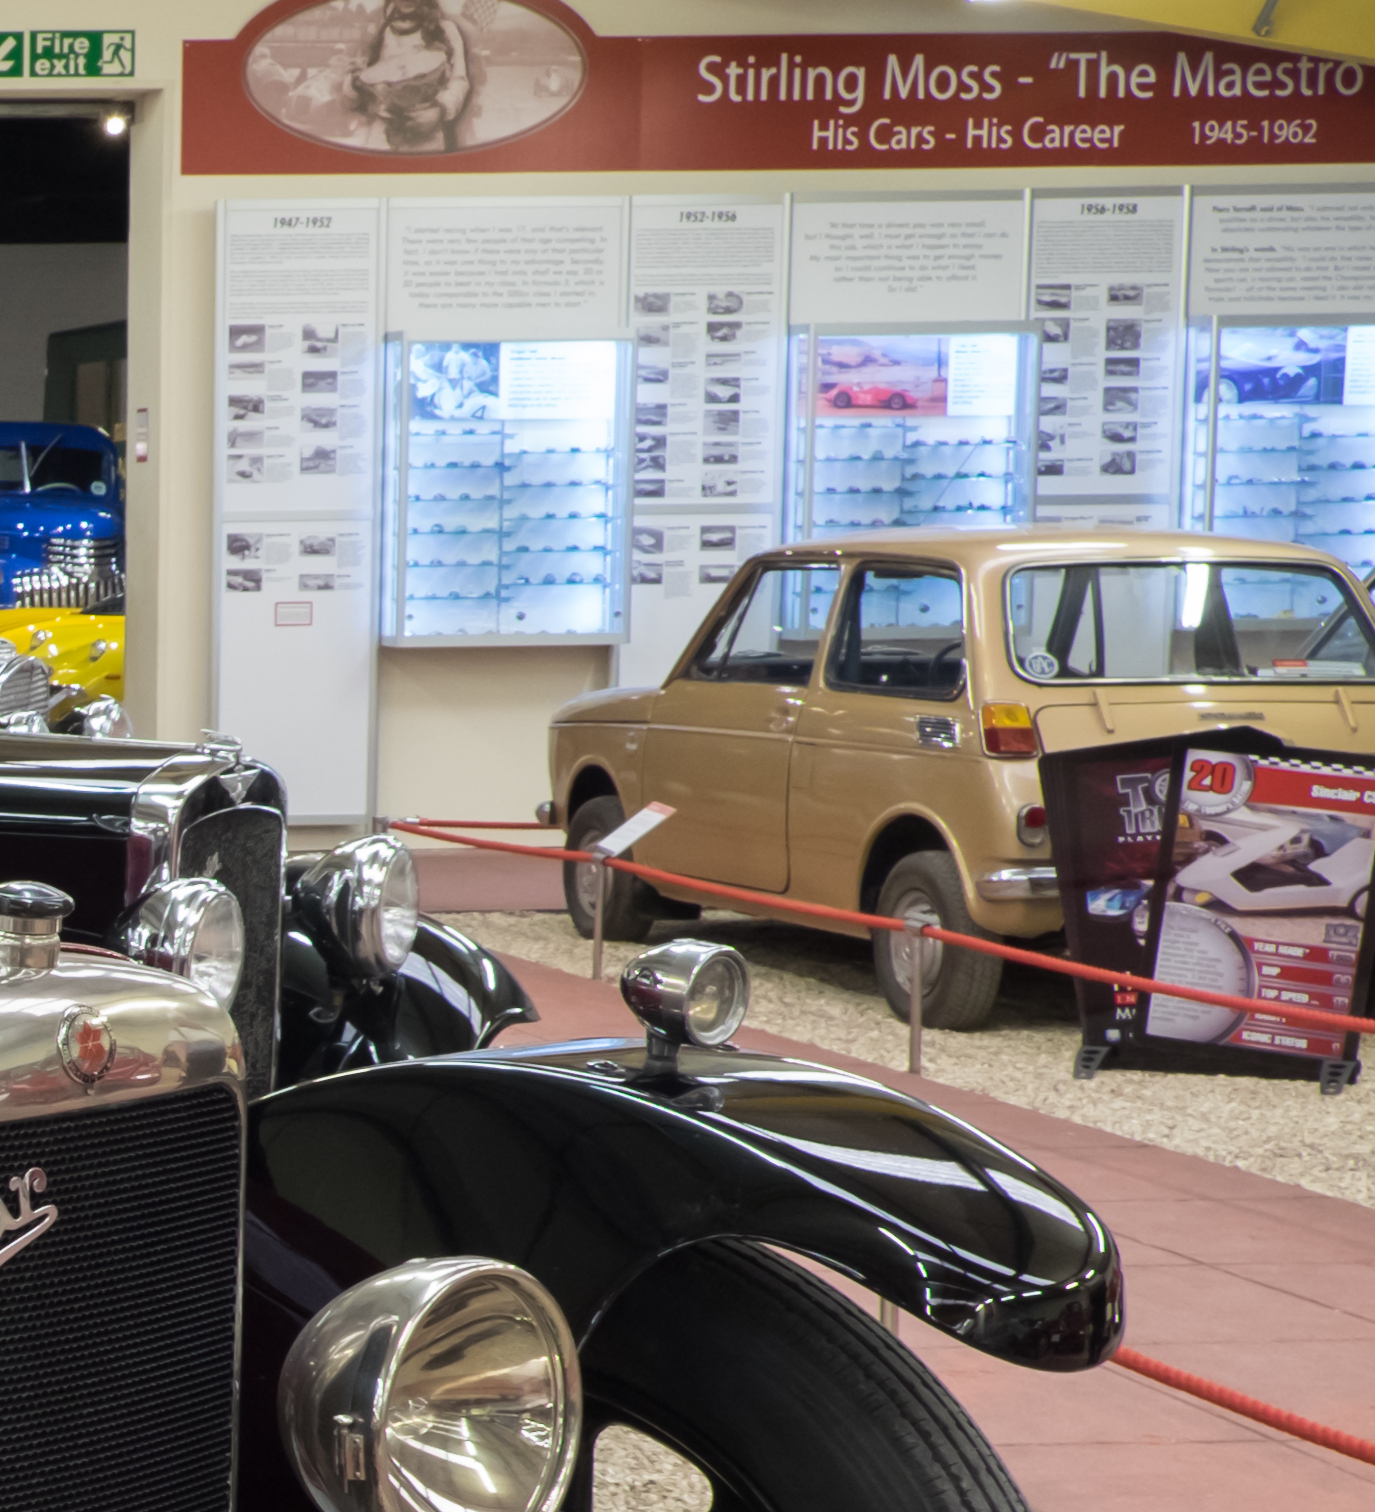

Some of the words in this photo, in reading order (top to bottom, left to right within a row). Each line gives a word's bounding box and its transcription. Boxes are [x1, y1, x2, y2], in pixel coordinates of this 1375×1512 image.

[35, 33, 90, 54] Fire
[34, 55, 86, 76] exit
[697, 52, 865, 112] Stirling
[884, 53, 1002, 100] Moss
[1173, 51, 1364, 98] Maestro
[811, 119, 859, 151] His
[868, 118, 935, 151] Cars
[965, 118, 1013, 150] His
[1022, 117, 1124, 149] Career
[1191, 119, 1318, 146] 1945-1962
[273, 216, 332, 228] 1947-1952
[679, 211, 737, 223] 1952-1956
[1187, 759, 1236, 795] 20
[1311, 785, 1360, 801] Sinclair
